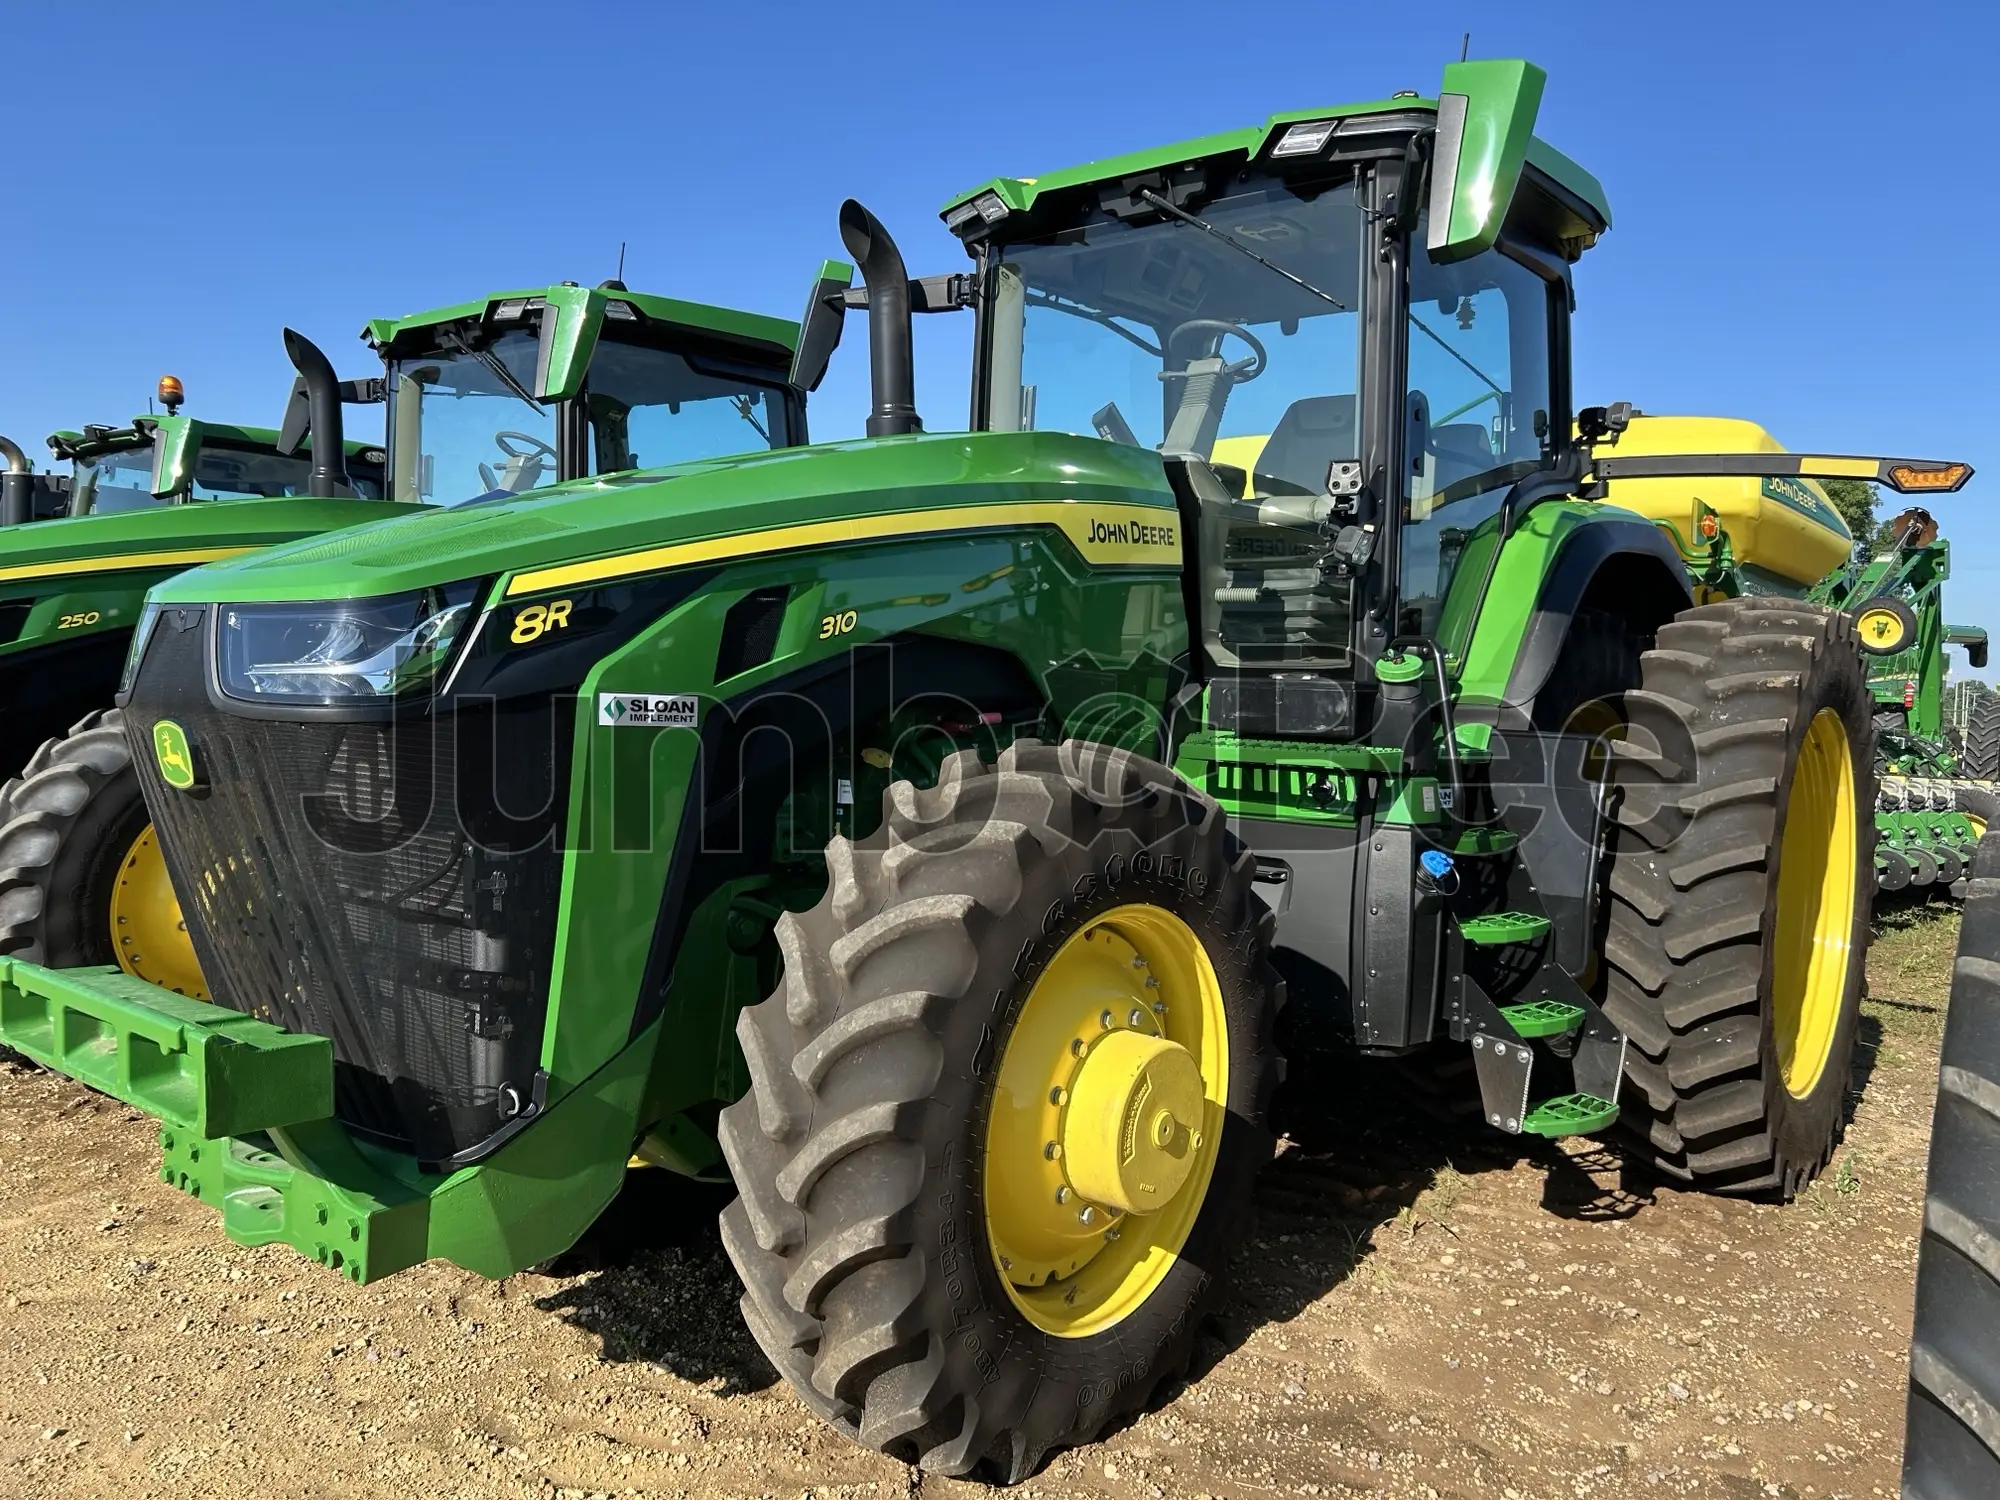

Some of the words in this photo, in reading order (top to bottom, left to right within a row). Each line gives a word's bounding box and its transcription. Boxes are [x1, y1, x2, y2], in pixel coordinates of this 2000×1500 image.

[1768, 476, 1793, 500] JOHN
[1793, 484, 1818, 513] DEERE
[1087, 517, 1129, 544] JOHN
[1129, 520, 1175, 546] DEERE
[57, 611, 100, 630] 250
[510, 599, 573, 644] 8R
[819, 609, 858, 640] 310
[629, 698, 695, 714] SLOAN
[629, 713, 695, 723] IMPLEMENT
